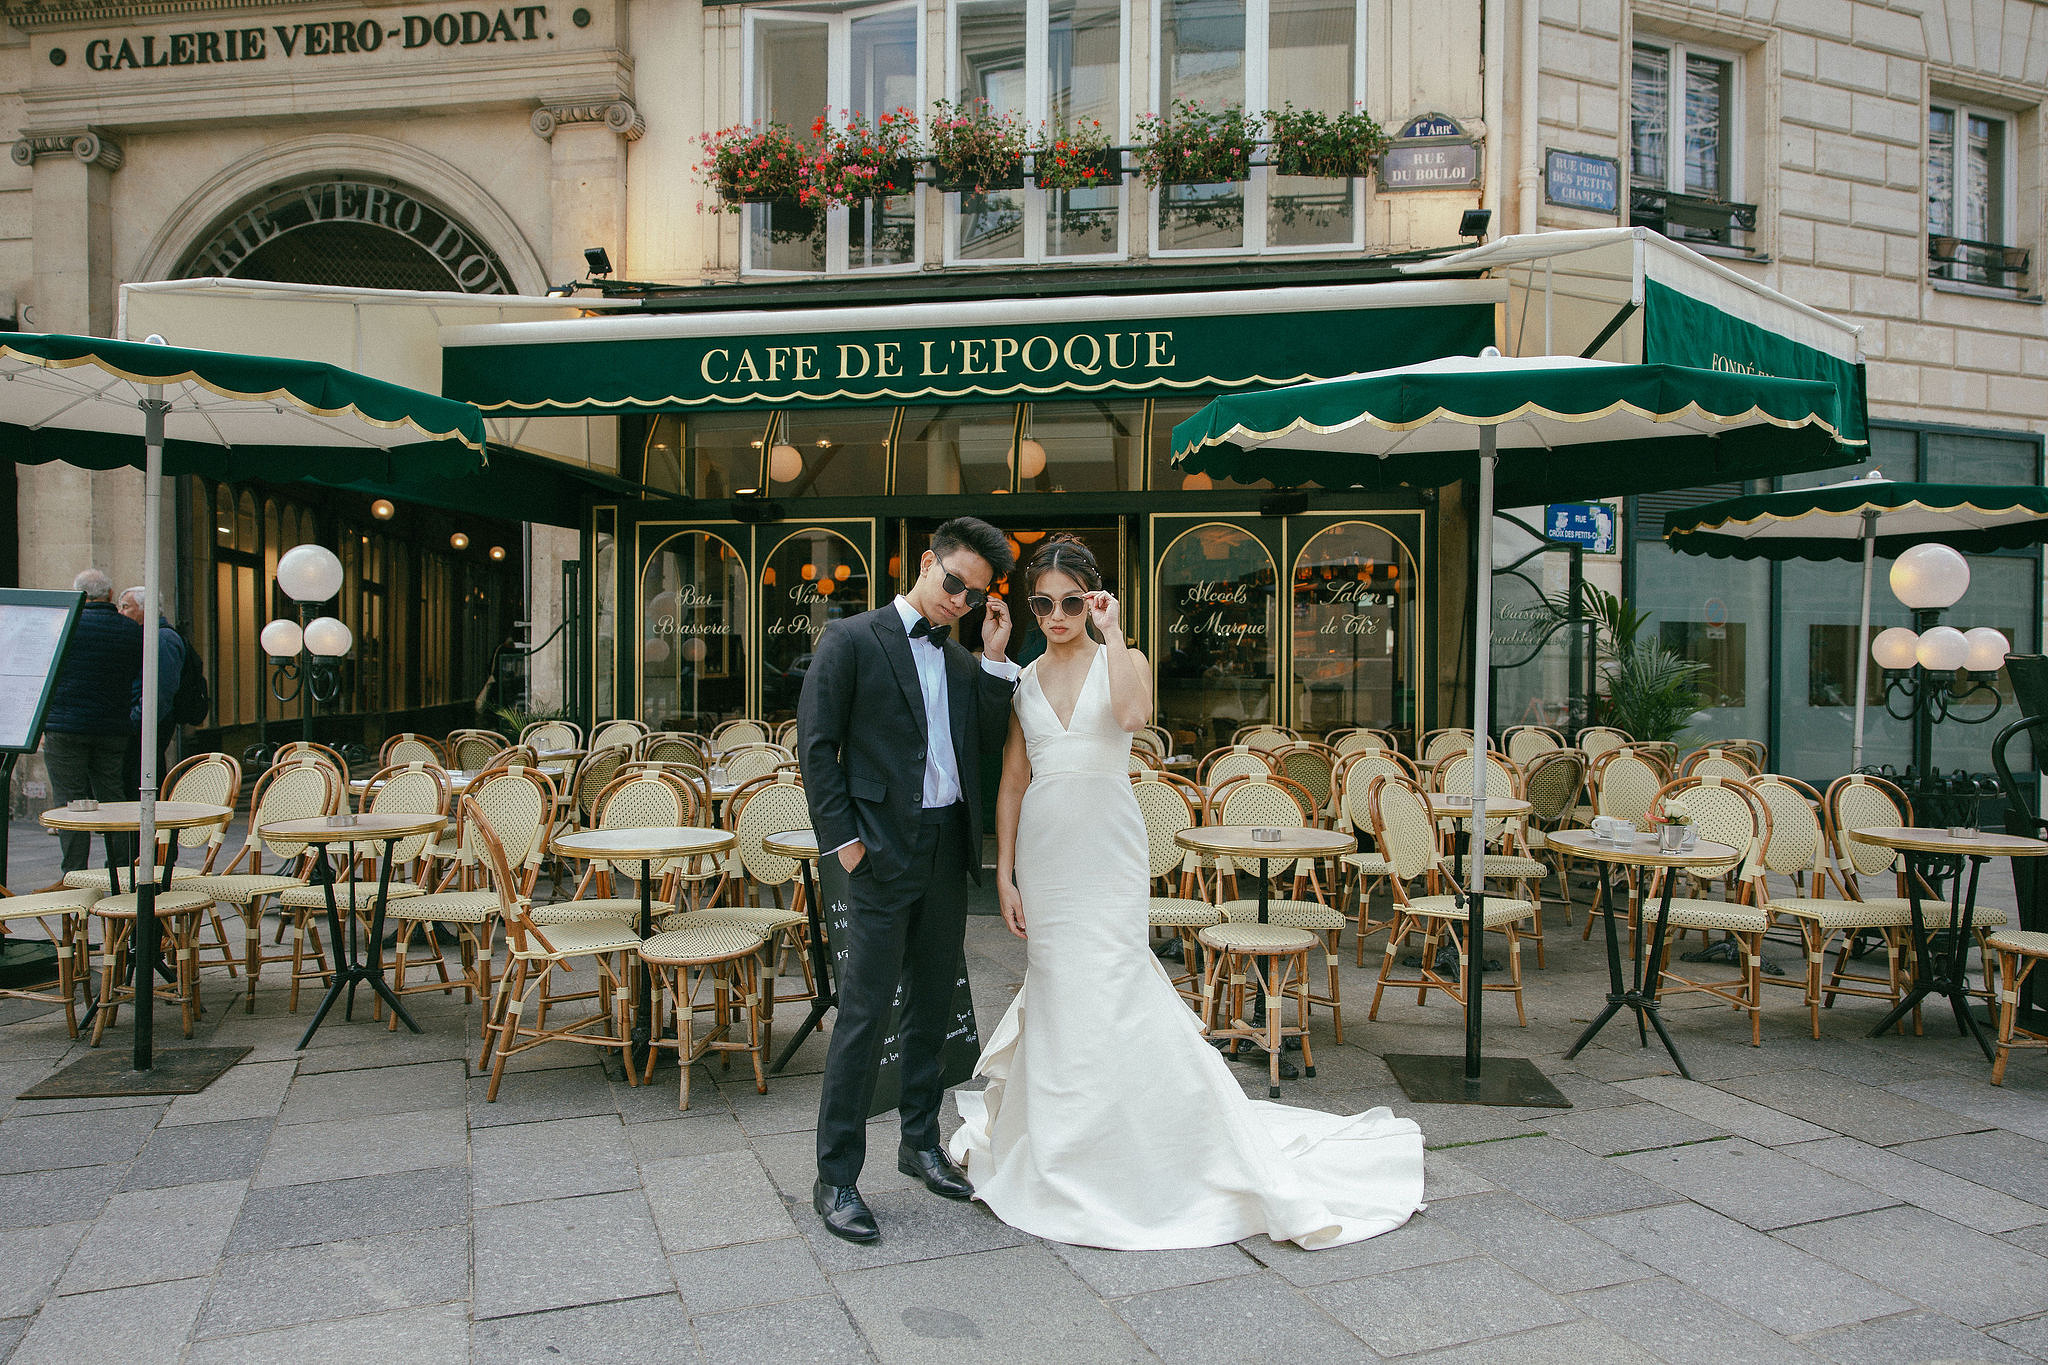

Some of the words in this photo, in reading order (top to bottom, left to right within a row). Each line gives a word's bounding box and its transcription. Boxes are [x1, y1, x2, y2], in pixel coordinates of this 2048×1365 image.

[85, 26, 266, 71] GALERIE
[1413, 152, 1446, 165] RUE
[1555, 157, 1577, 172] RUE
[1579, 162, 1611, 178] CROIX
[1392, 170, 1410, 182] DU
[1416, 167, 1466, 181] BOULOI
[1553, 172, 1574, 186] DES
[1576, 174, 1613, 191] PETITS
[302, 183, 424, 234] VERO
[700, 345, 820, 385] CAFE
[835, 342, 904, 380] DE
[919, 331, 1177, 377] L'EPOQUE
[1574, 515, 1588, 524] RUE
[1549, 529, 1565, 538] CROIX
[1565, 530, 1575, 539] DES
[679, 584, 713, 606] Bar
[789, 583, 829, 606] Vins
[1181, 579, 1248, 606] Alcools
[1320, 581, 1383, 606] Salon
[652, 614, 731, 635] Brasserie
[768, 617, 785, 635] de
[1169, 614, 1189, 634] de
[1194, 611, 1266, 646] Marque
[1320, 616, 1338, 635] de
[1341, 613, 1380, 635] Thé
